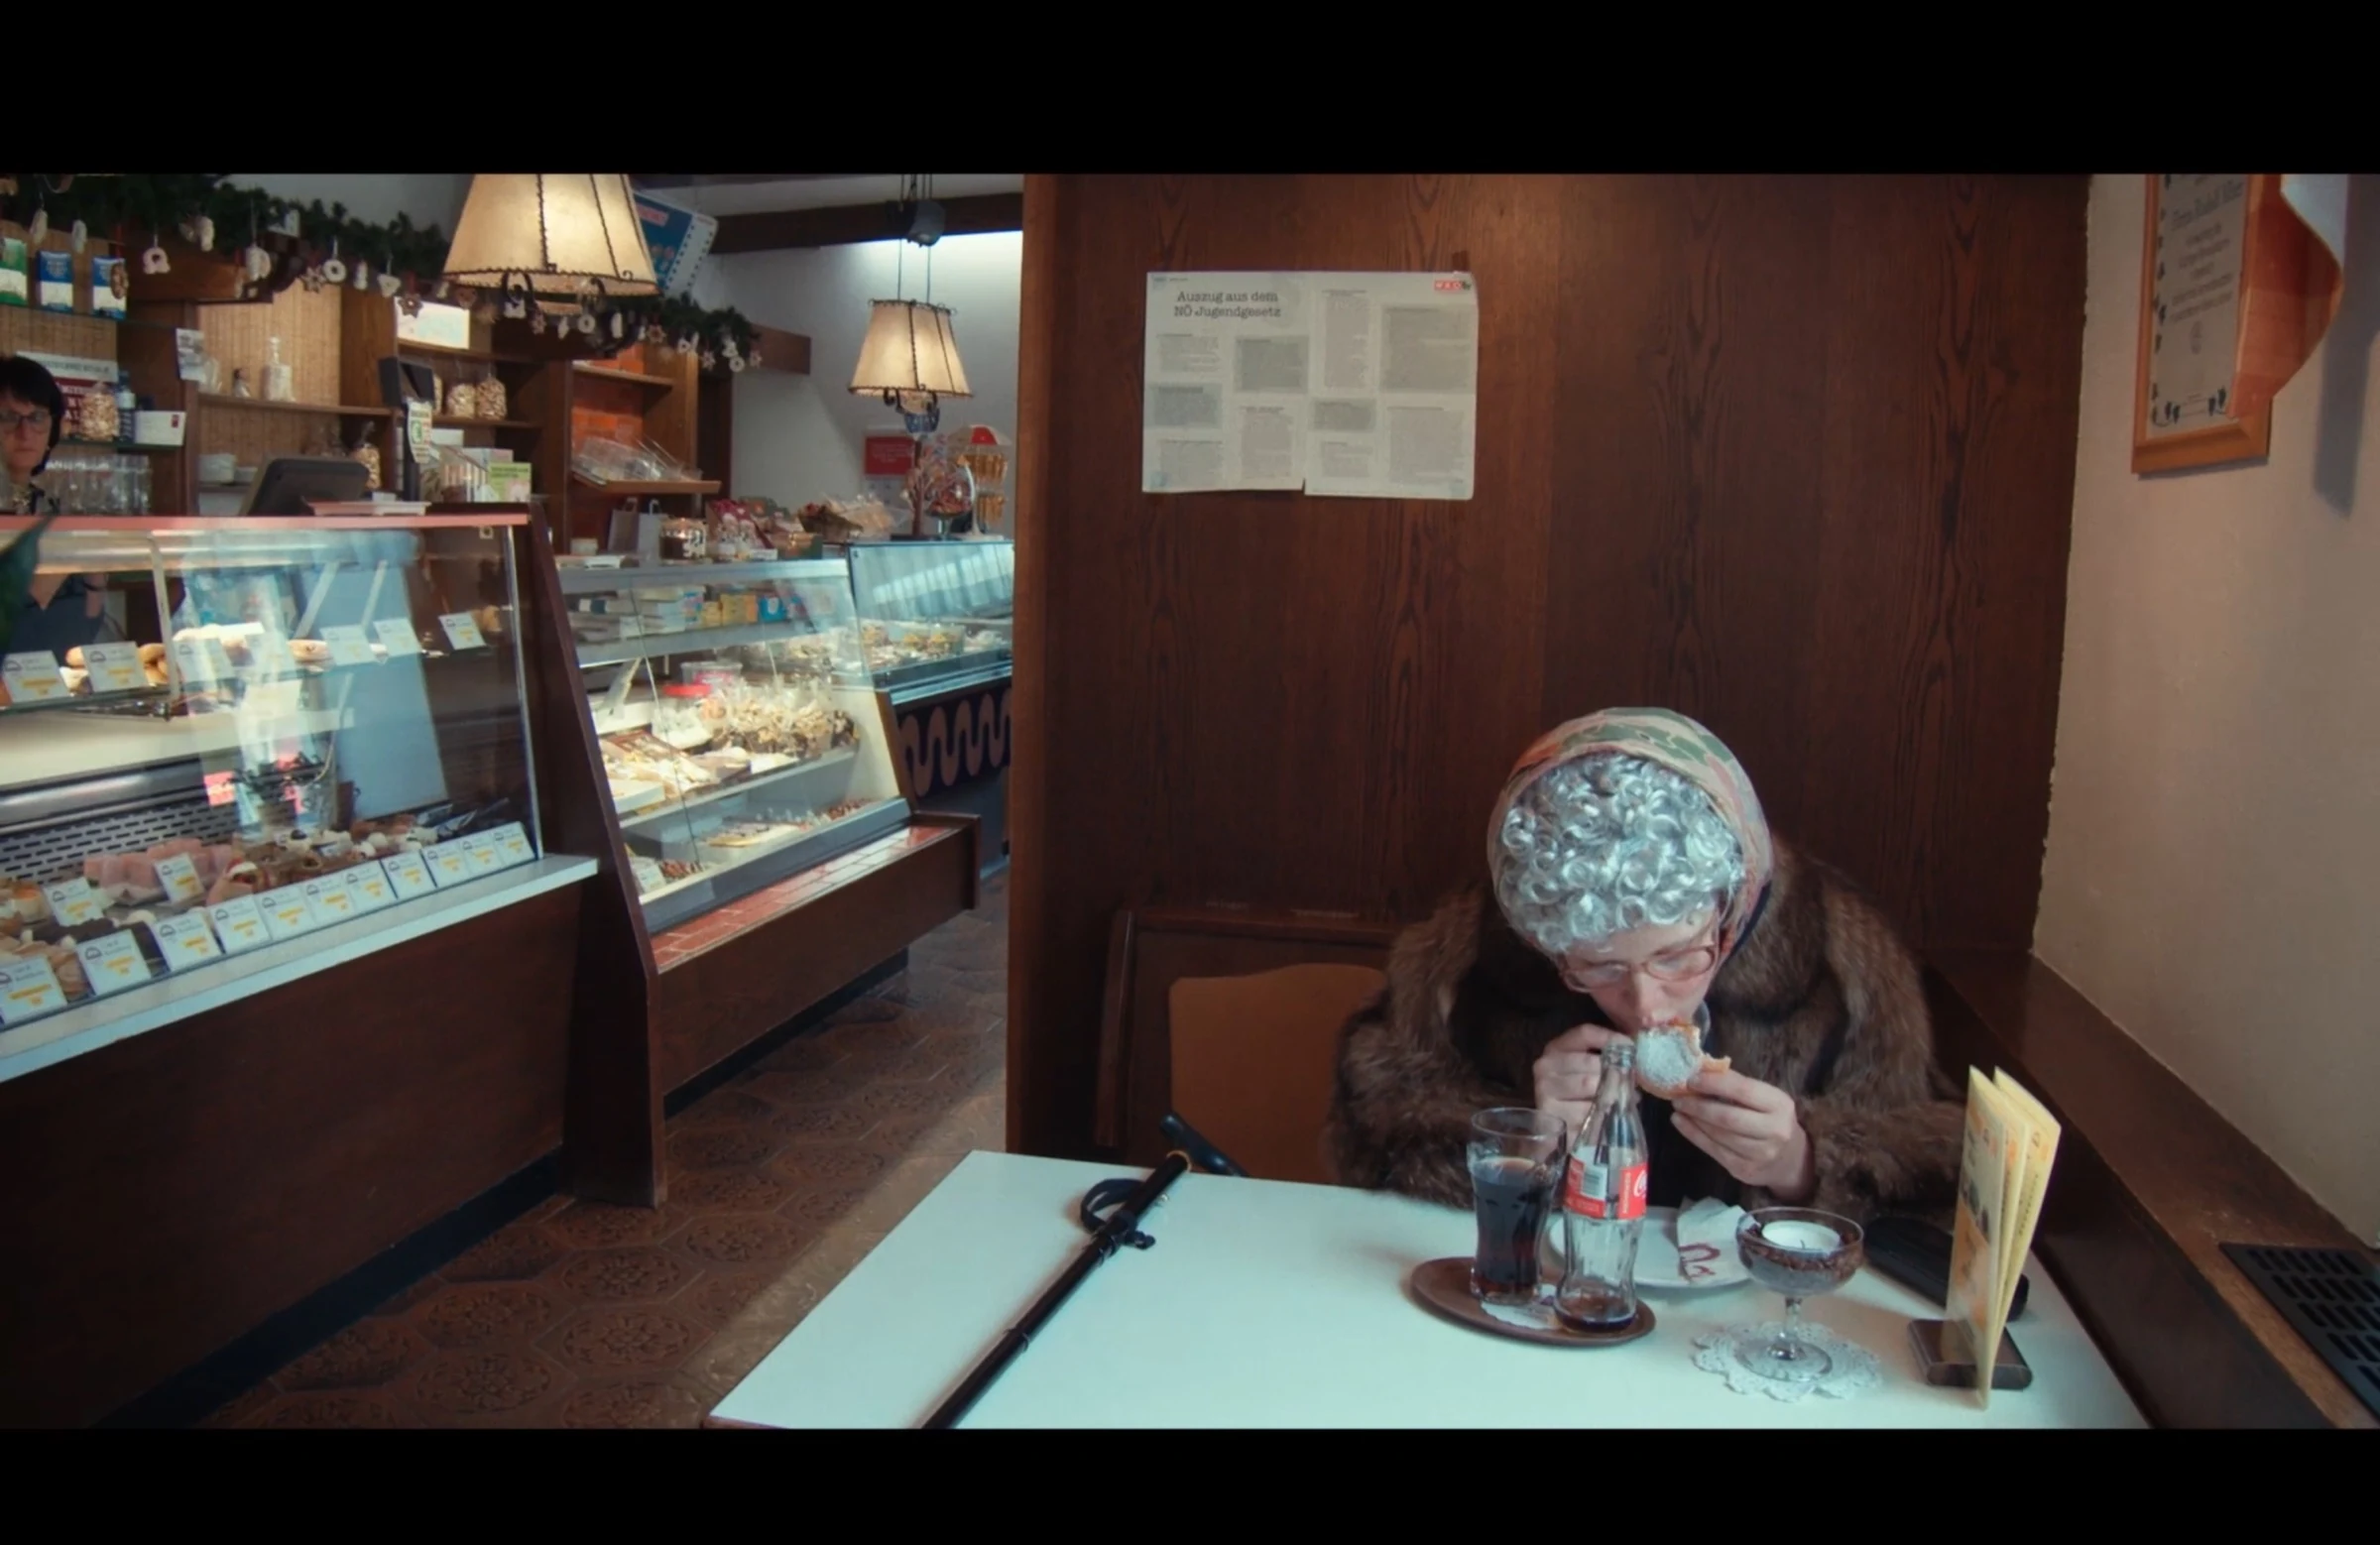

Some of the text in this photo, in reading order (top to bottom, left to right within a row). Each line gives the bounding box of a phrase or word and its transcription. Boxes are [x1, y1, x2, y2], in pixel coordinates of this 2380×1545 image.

[1176, 291, 1279, 303] Auszug aus dem
[1173, 303, 1282, 319] NÖ Jugendgesetz
